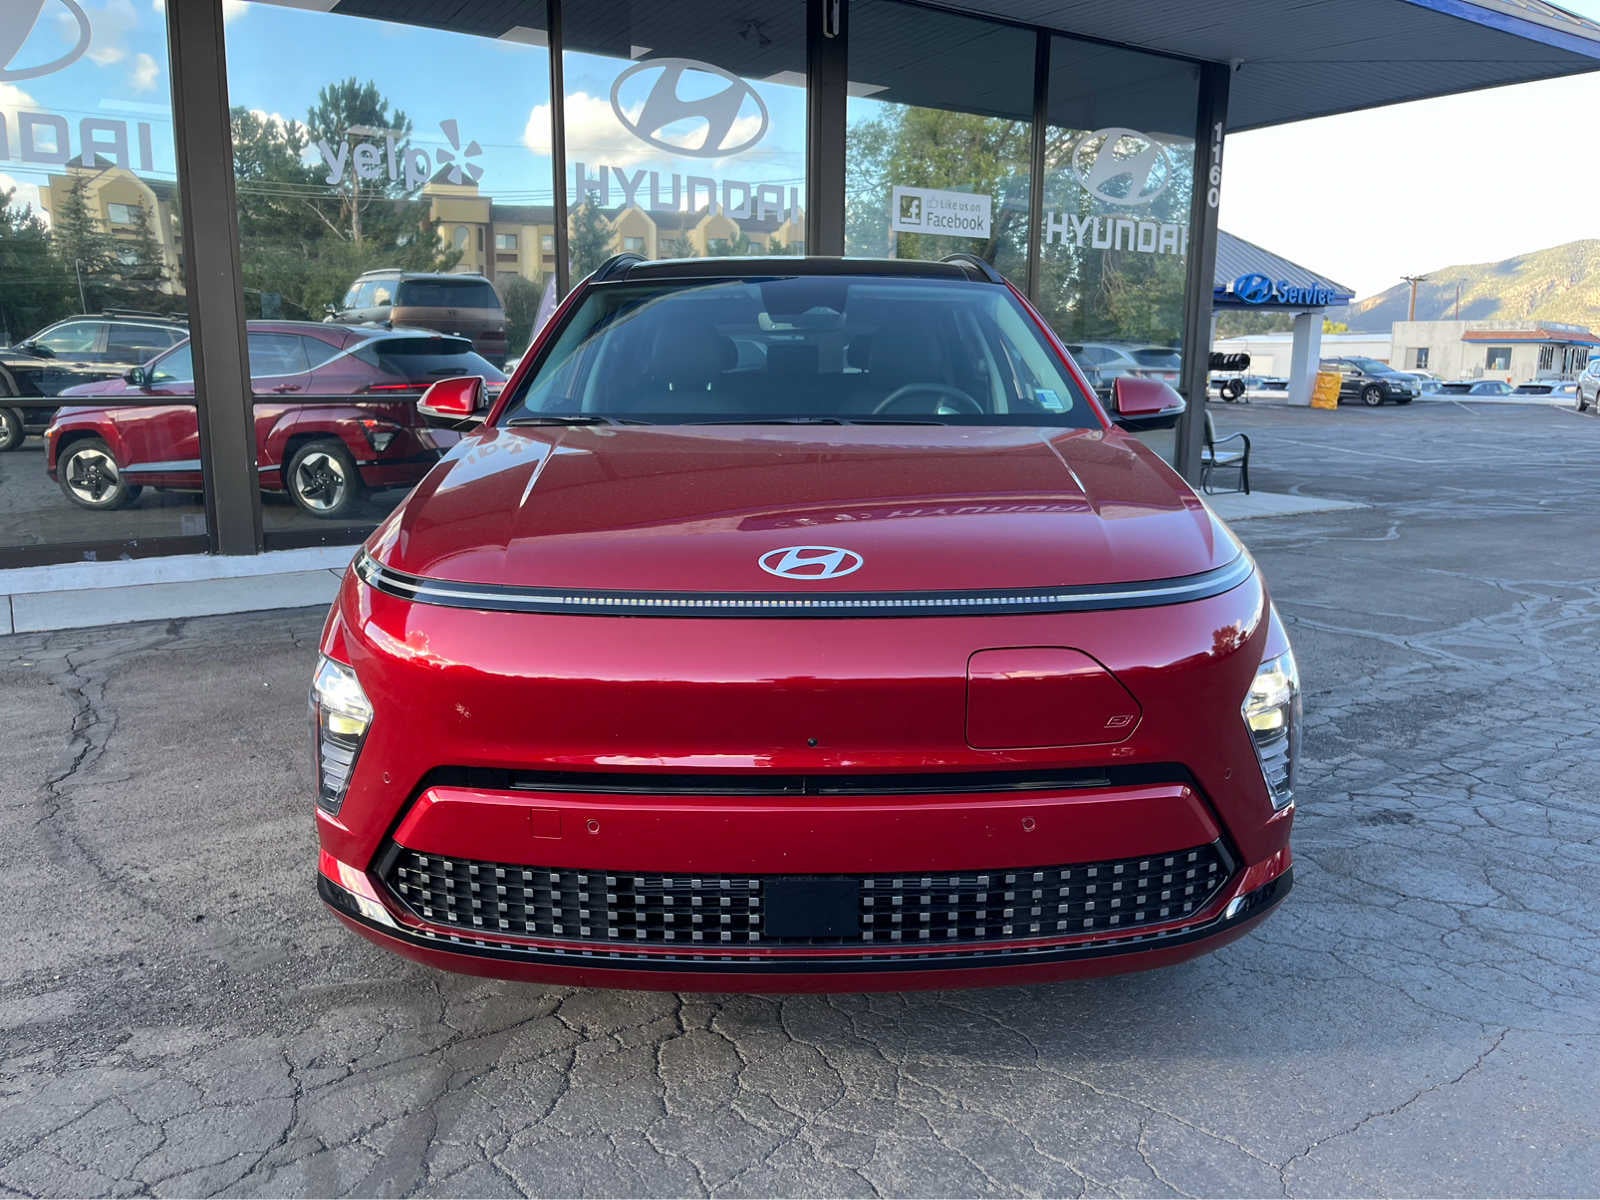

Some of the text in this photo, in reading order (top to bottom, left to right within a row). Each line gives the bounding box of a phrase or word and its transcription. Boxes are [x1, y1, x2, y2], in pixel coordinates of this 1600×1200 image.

[318, 135, 431, 191] yelp
[1207, 122, 1223, 208] 1160
[575, 162, 799, 224] HYUNDAI
[940, 199, 958, 210] Like
[959, 202, 969, 210] us
[926, 211, 984, 231] Facebook
[1045, 211, 1188, 255] HYUNDAI
[1276, 281, 1336, 305] Service
